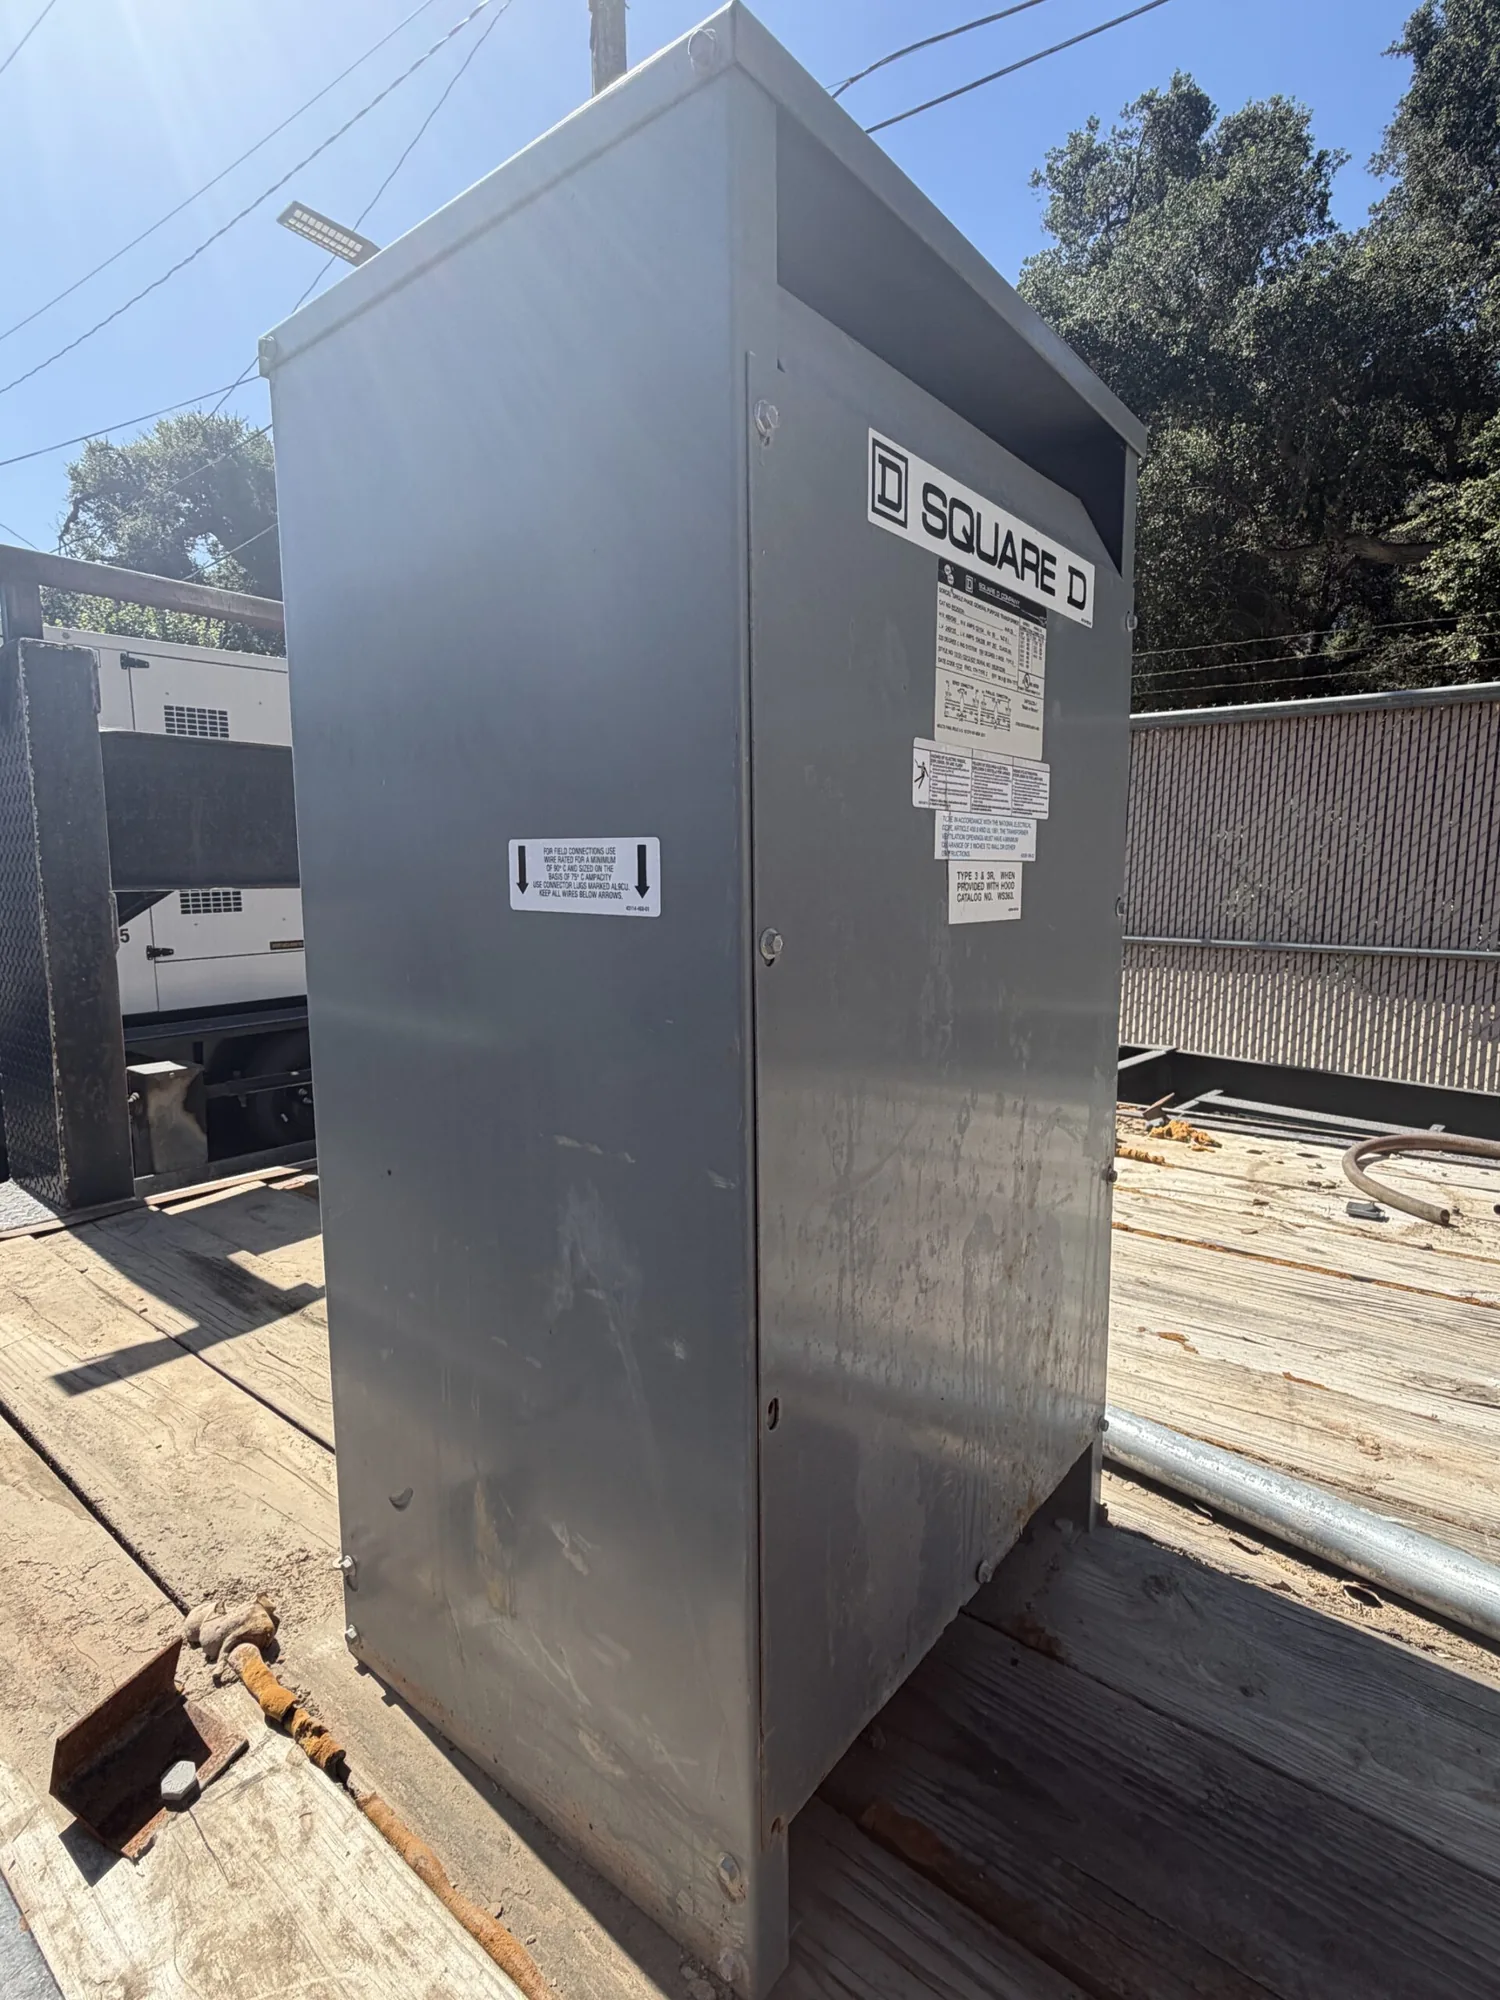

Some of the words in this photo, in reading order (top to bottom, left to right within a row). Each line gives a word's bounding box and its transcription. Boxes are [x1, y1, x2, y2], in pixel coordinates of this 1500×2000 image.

[922, 482, 1056, 597] SQUARE
[1067, 565, 1086, 610] D
[1001, 593, 1020, 605] COMPANY
[543, 847, 553, 855] FOR
[554, 847, 567, 855] FIELD
[569, 847, 604, 855] CONNECTIONS
[605, 847, 616, 855] USE
[544, 856, 557, 864] WIRE
[557, 856, 573, 864] RATED
[546, 864, 553, 872] OF
[564, 873, 570, 881] OF
[581, 873, 584, 881] C
[585, 873, 612, 881] AMPACITY
[957, 871, 972, 880] TYPE
[975, 871, 978, 880] 3
[981, 871, 984, 880] &
[1000, 872, 1015, 880] WHEN
[543, 881, 573, 889] CONNECTOR
[573, 882, 587, 890] LUGS
[588, 882, 609, 890] MARKED
[957, 882, 985, 891] PROVIDED
[986, 882, 999, 890] WITH
[1001, 881, 1015, 890] HOOD
[562, 890, 578, 898] WIRES
[579, 891, 598, 899] BELOW
[598, 891, 623, 900] ARROWS.
[957, 892, 982, 902] CATALOG
[984, 892, 993, 901] NO.
[120, 928, 130, 943] 5
